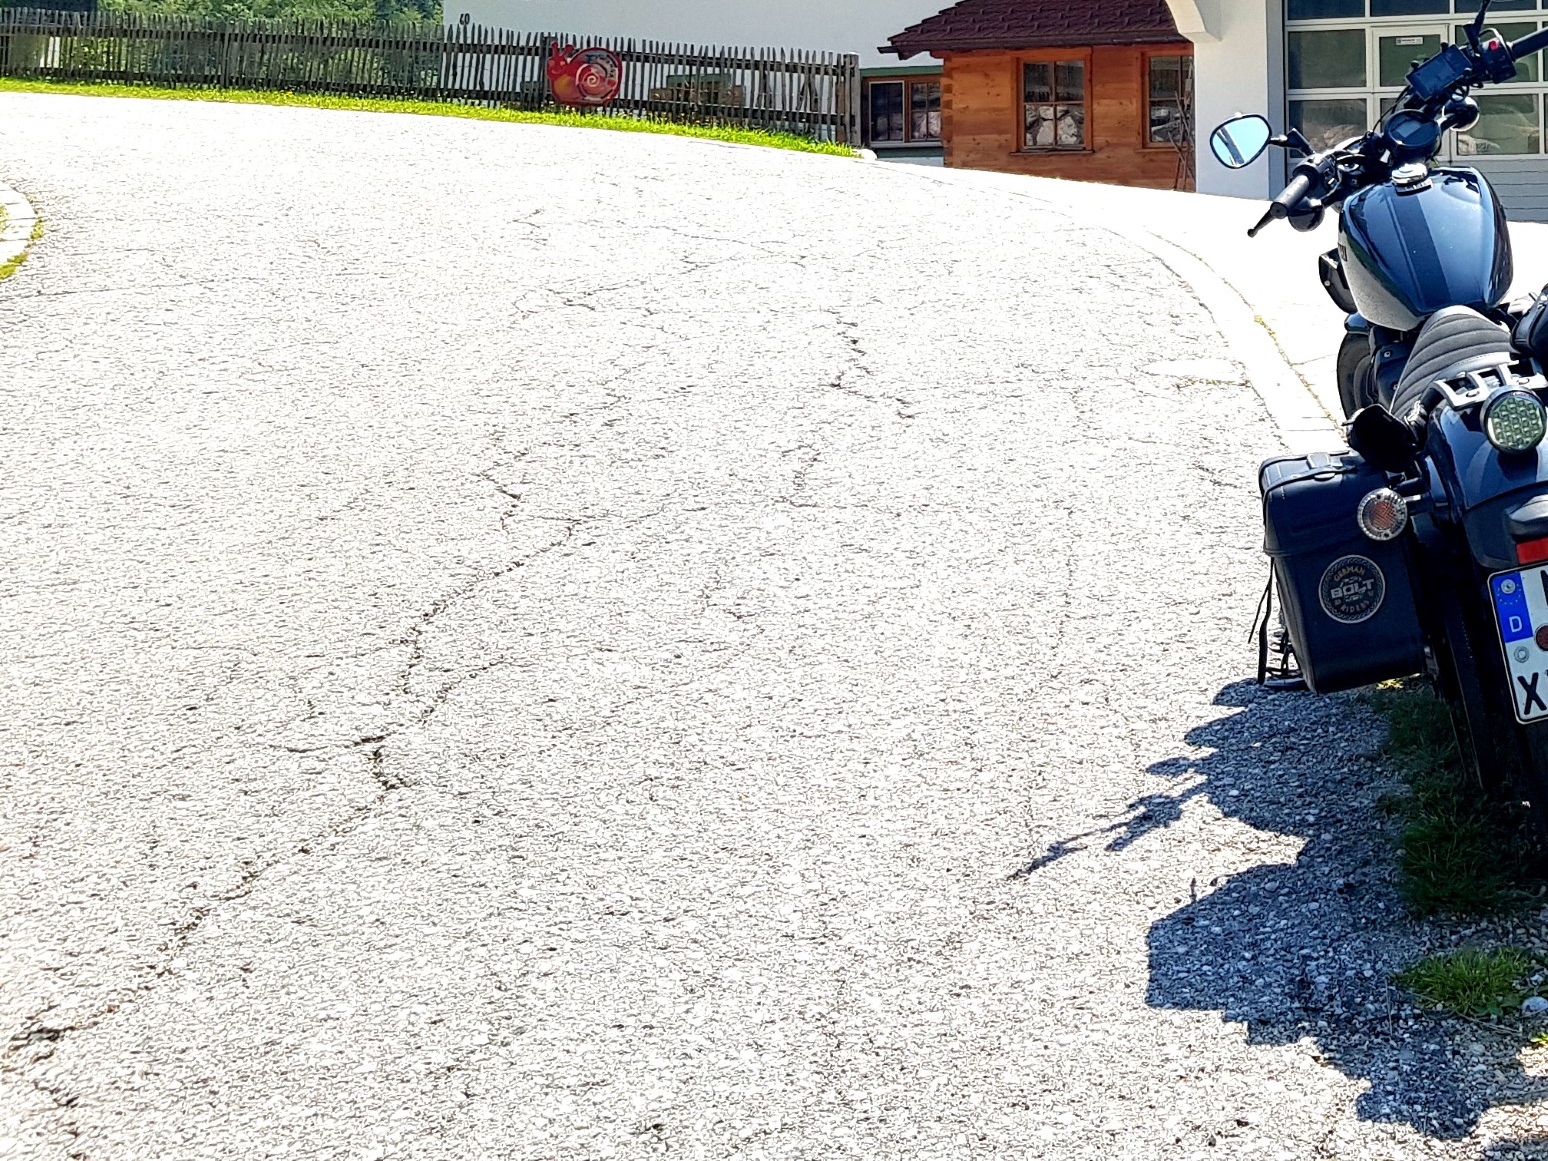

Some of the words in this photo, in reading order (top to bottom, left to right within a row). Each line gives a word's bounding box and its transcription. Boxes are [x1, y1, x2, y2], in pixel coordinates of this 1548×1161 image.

[1333, 565, 1366, 582] GERMAN
[1330, 579, 1375, 599] BOLT
[1508, 616, 1523, 633] D
